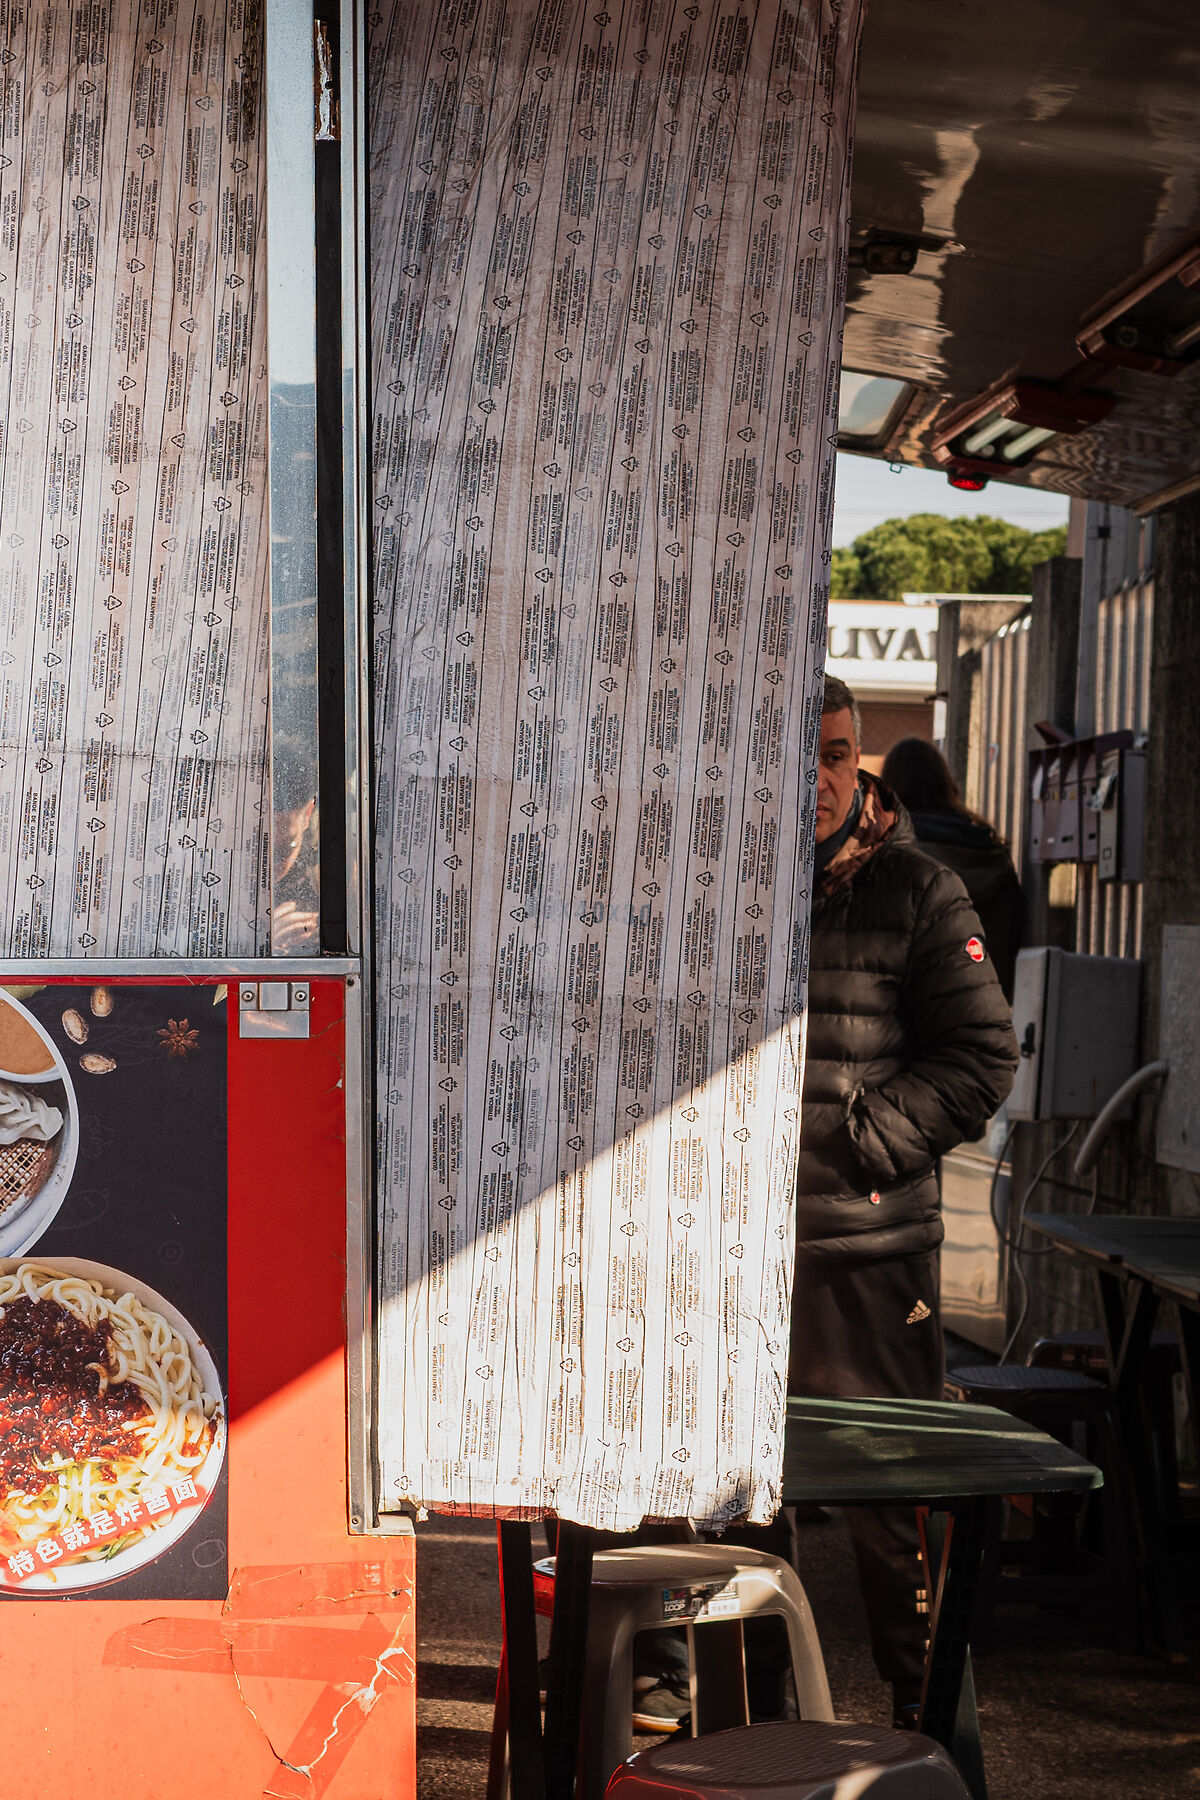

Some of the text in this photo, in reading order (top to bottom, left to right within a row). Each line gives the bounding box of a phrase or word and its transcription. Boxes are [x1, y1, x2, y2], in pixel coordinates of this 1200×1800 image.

[711, 16, 725, 70] GARANTIESTREIFEN
[748, 252, 756, 285] GUARANTEE
[157, 465, 167, 520] GARANTIESTREIFEN
[723, 459, 733, 515] GARANTIESTREIFEN
[530, 495, 539, 551] GARANTIESTREIFEN
[761, 597, 771, 652] GARANTIESTREIFEN
[194, 676, 202, 705] GARANTIA
[771, 709, 779, 738] GARANTIA
[692, 798, 702, 854] GARANTIESTREIFEN
[506, 834, 516, 890] GARANTIESTREIFEN
[480, 1174, 488, 1230] GARANTIESTREIFEN
